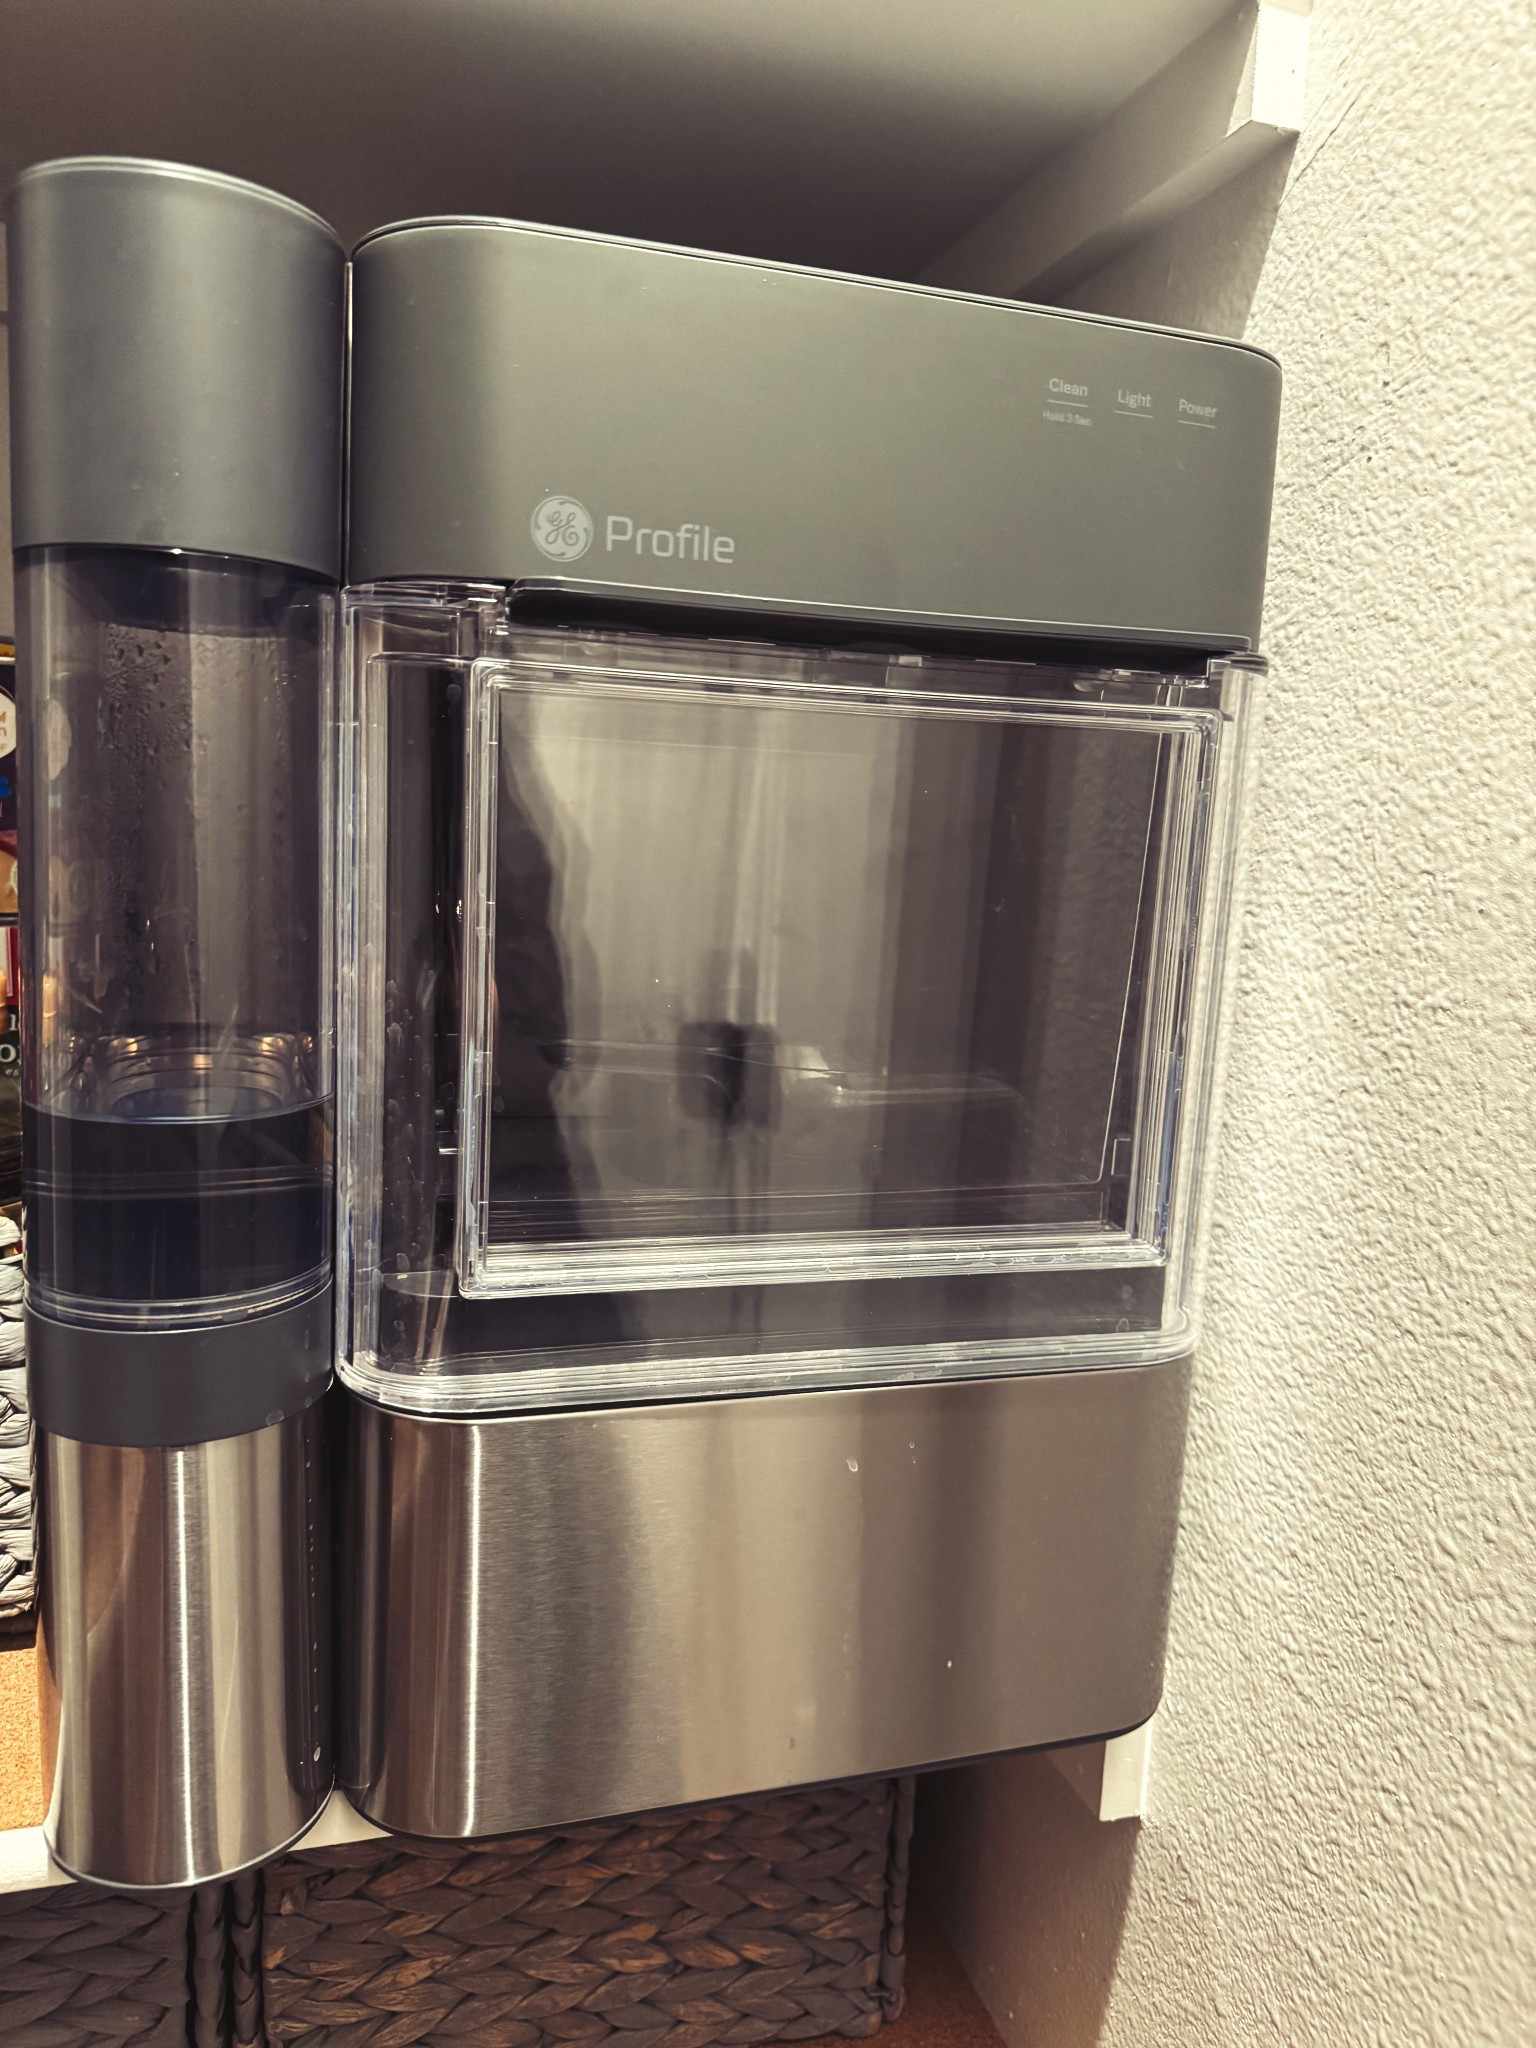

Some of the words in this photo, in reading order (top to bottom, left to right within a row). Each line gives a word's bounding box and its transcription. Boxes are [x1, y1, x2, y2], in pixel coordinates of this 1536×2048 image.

[1049, 377, 1088, 396] Clean
[1117, 389, 1152, 408] Light
[1178, 398, 1218, 418] Power
[1042, 410, 1064, 423] Hold
[606, 515, 735, 564] Profile
